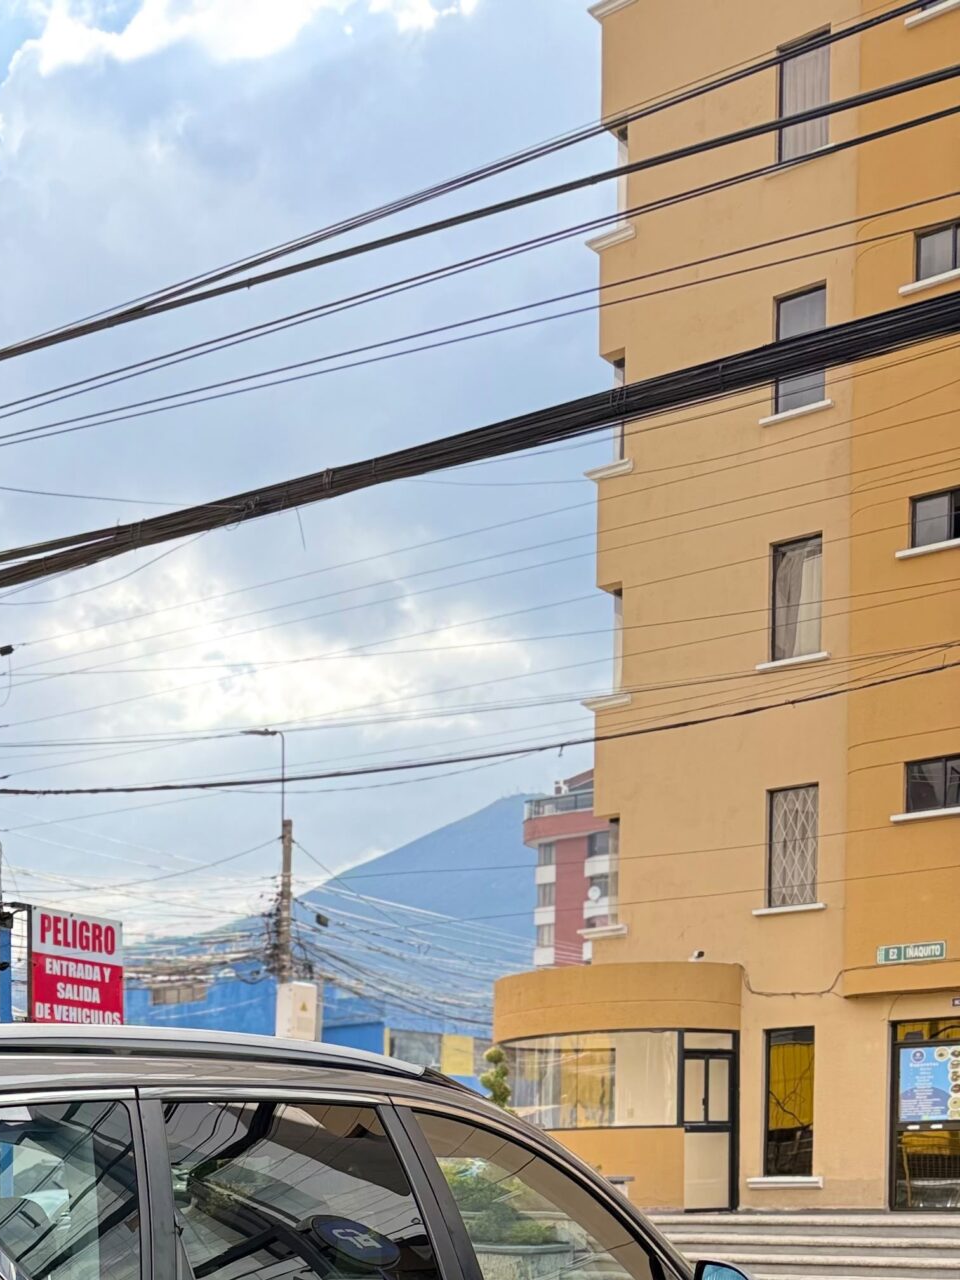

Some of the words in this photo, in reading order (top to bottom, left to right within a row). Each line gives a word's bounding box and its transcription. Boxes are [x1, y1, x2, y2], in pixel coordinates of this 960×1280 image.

[40, 913, 115, 955] PELIGRO
[45, 958, 101, 982] ENTRADA
[103, 967, 112, 983] Y
[56, 982, 101, 1004] SALIDA
[35, 1001, 52, 1020] DE
[53, 1004, 121, 1025] VEHICULOS
